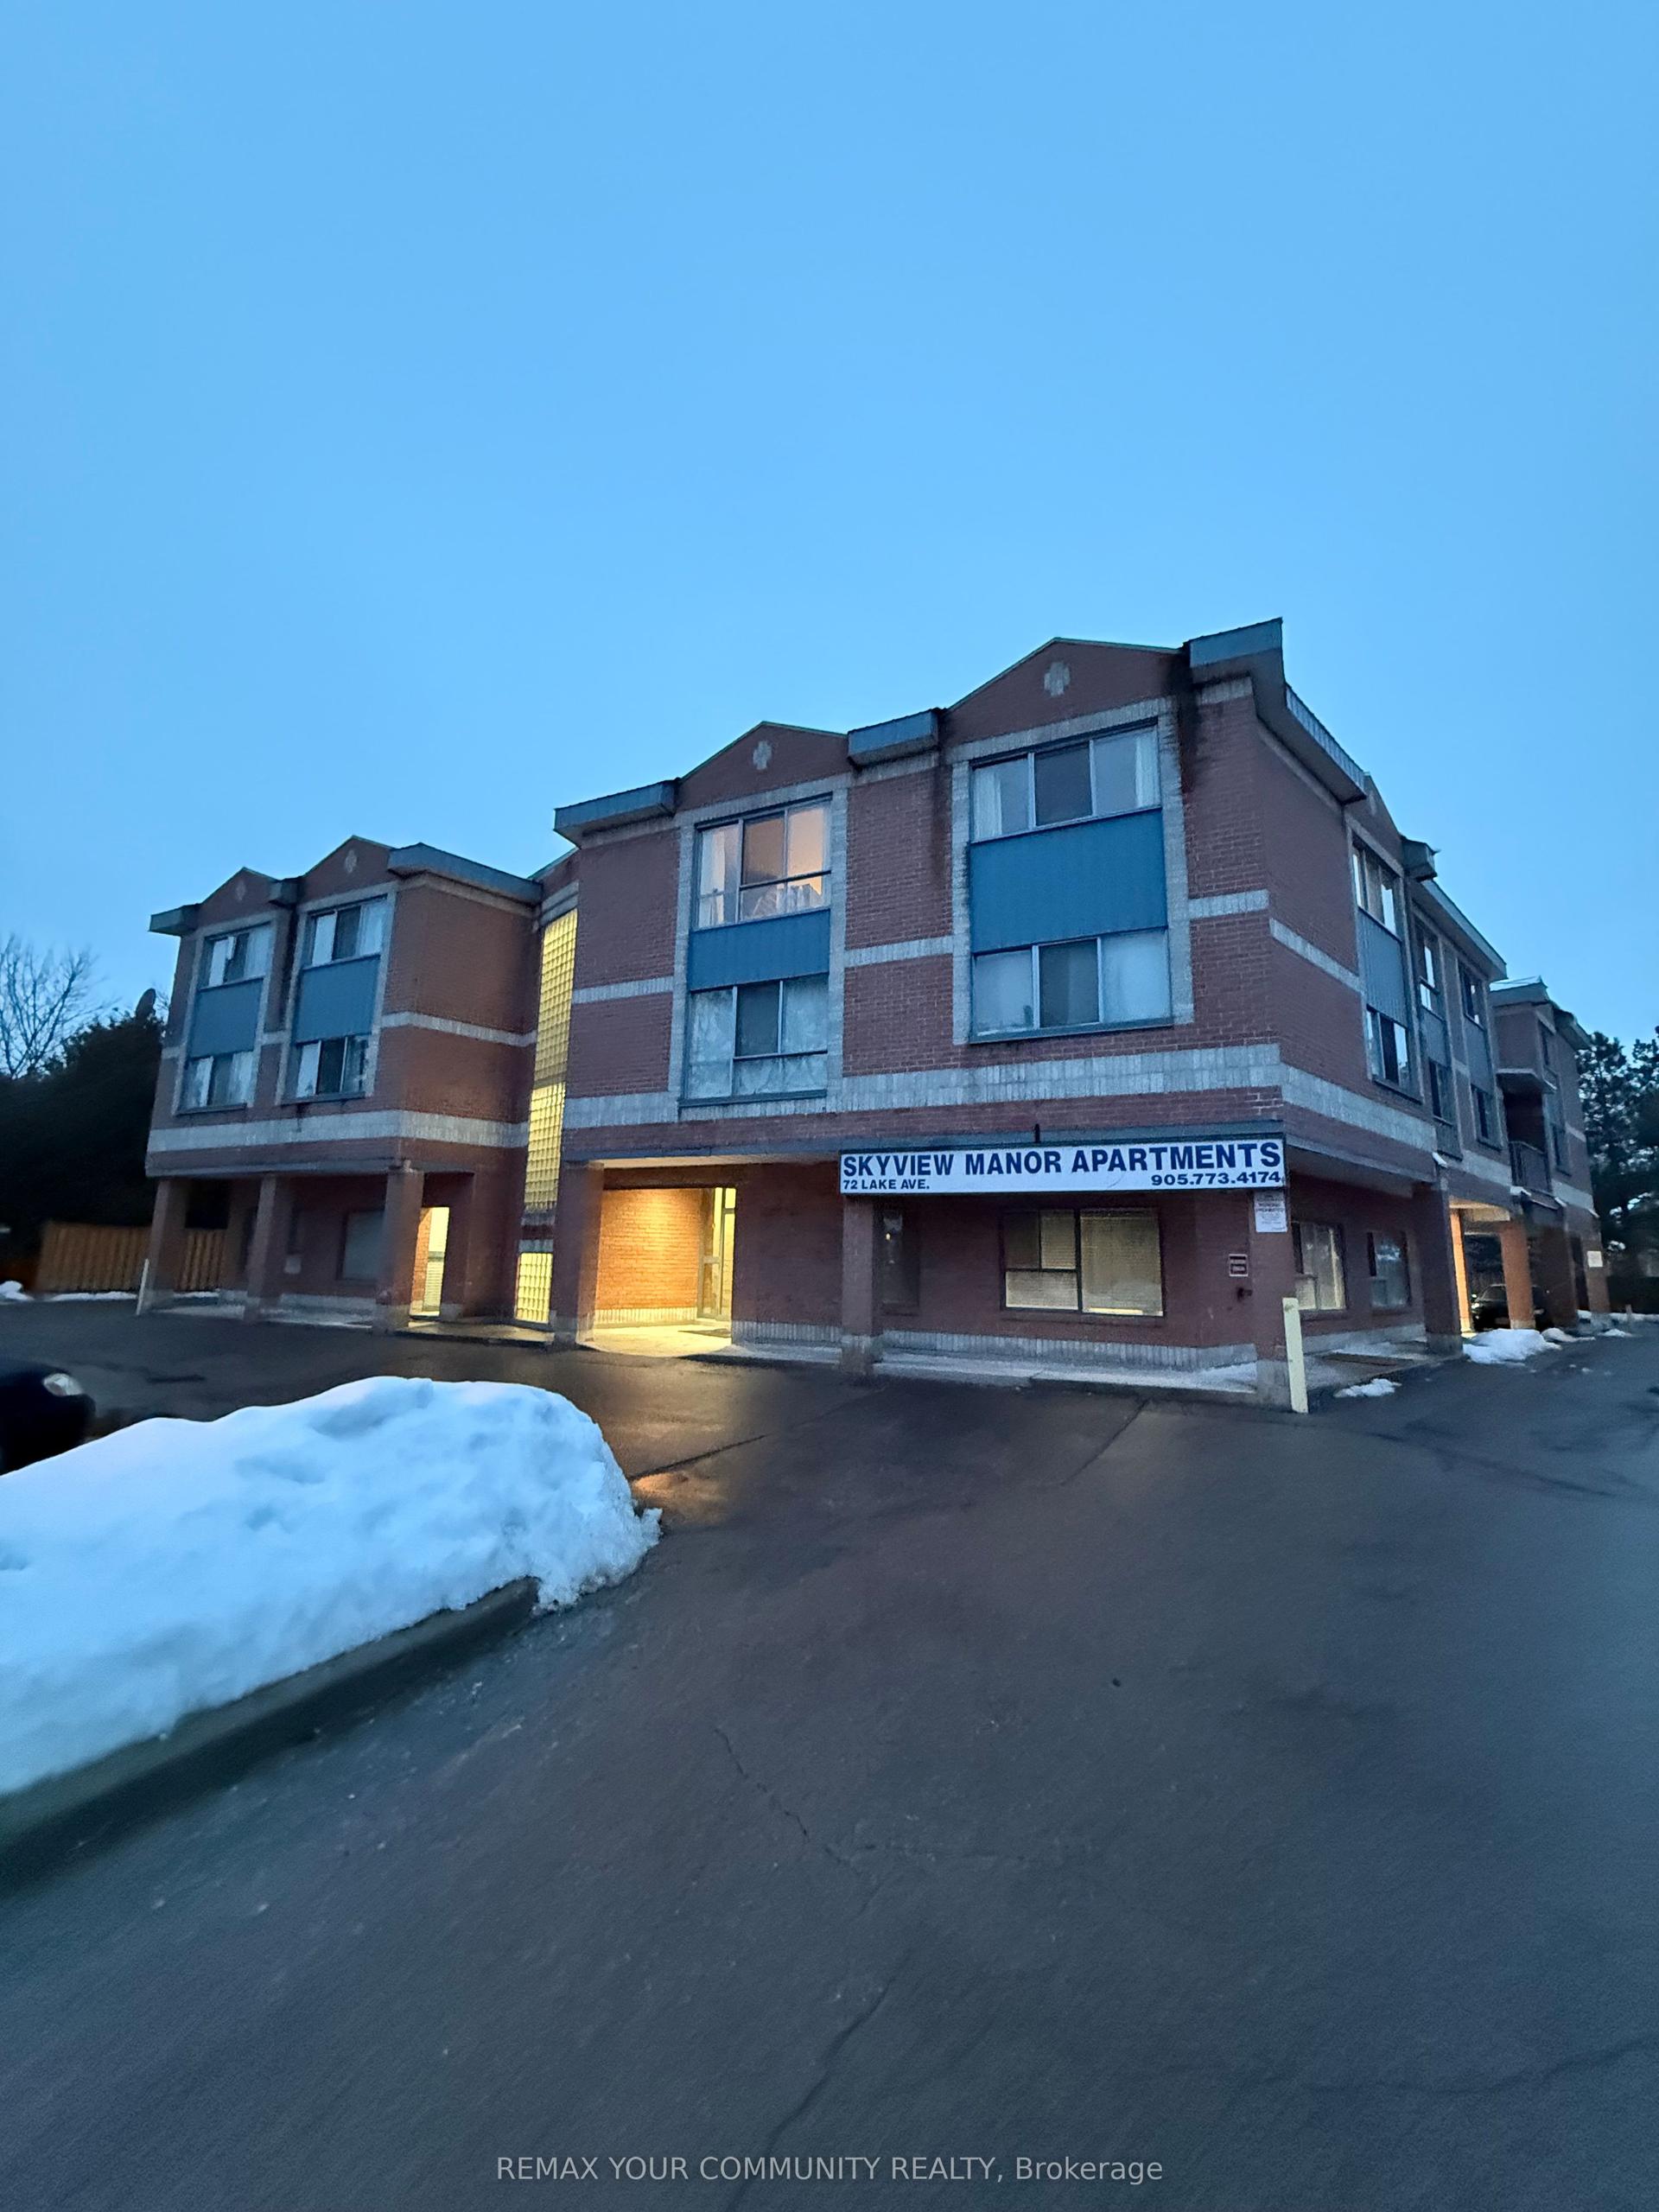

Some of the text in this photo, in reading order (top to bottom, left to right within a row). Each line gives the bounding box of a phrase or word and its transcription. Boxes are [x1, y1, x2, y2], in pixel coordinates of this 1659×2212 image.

[843, 1142, 1281, 1177] SKYVIEW MANOR APARTMENTS
[843, 1179, 930, 1190] 72 LAKE AVE.
[1151, 1172, 1281, 1186] 905.773.4174
